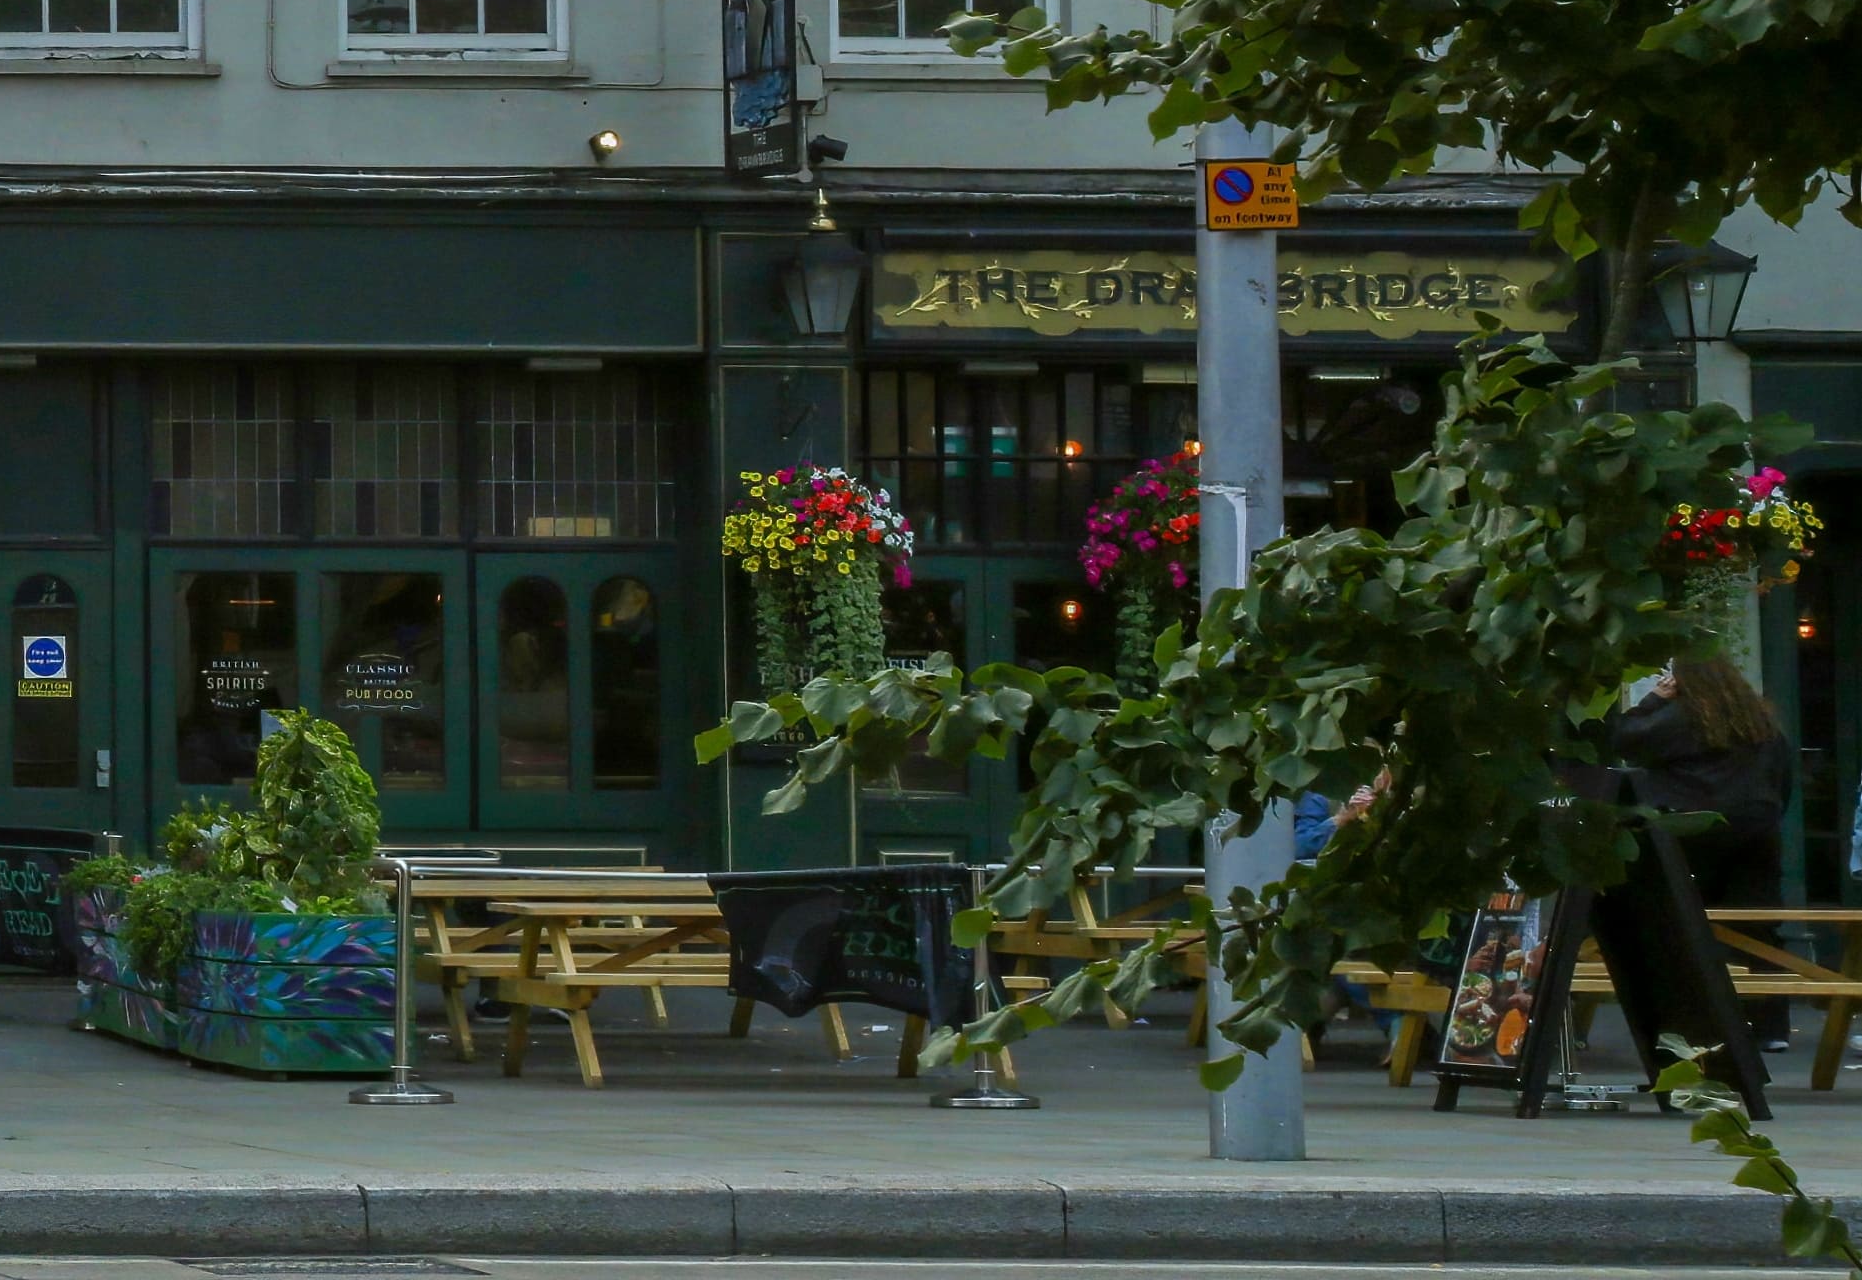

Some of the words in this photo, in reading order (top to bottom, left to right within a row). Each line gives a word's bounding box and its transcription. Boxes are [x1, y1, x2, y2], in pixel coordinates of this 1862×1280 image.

[1267, 166, 1282, 177] At
[1263, 183, 1287, 193] any
[1261, 195, 1291, 205] time
[1214, 214, 1231, 224] on
[1236, 211, 1293, 224] footway
[933, 270, 1061, 306] THE
[212, 661, 259, 669] BRITISH
[346, 664, 414, 674] CLASSIC
[22, 682, 69, 690] CAUTION
[206, 677, 265, 690] SPIRITS
[346, 689, 371, 699] PUB
[376, 689, 413, 699] FOOD
